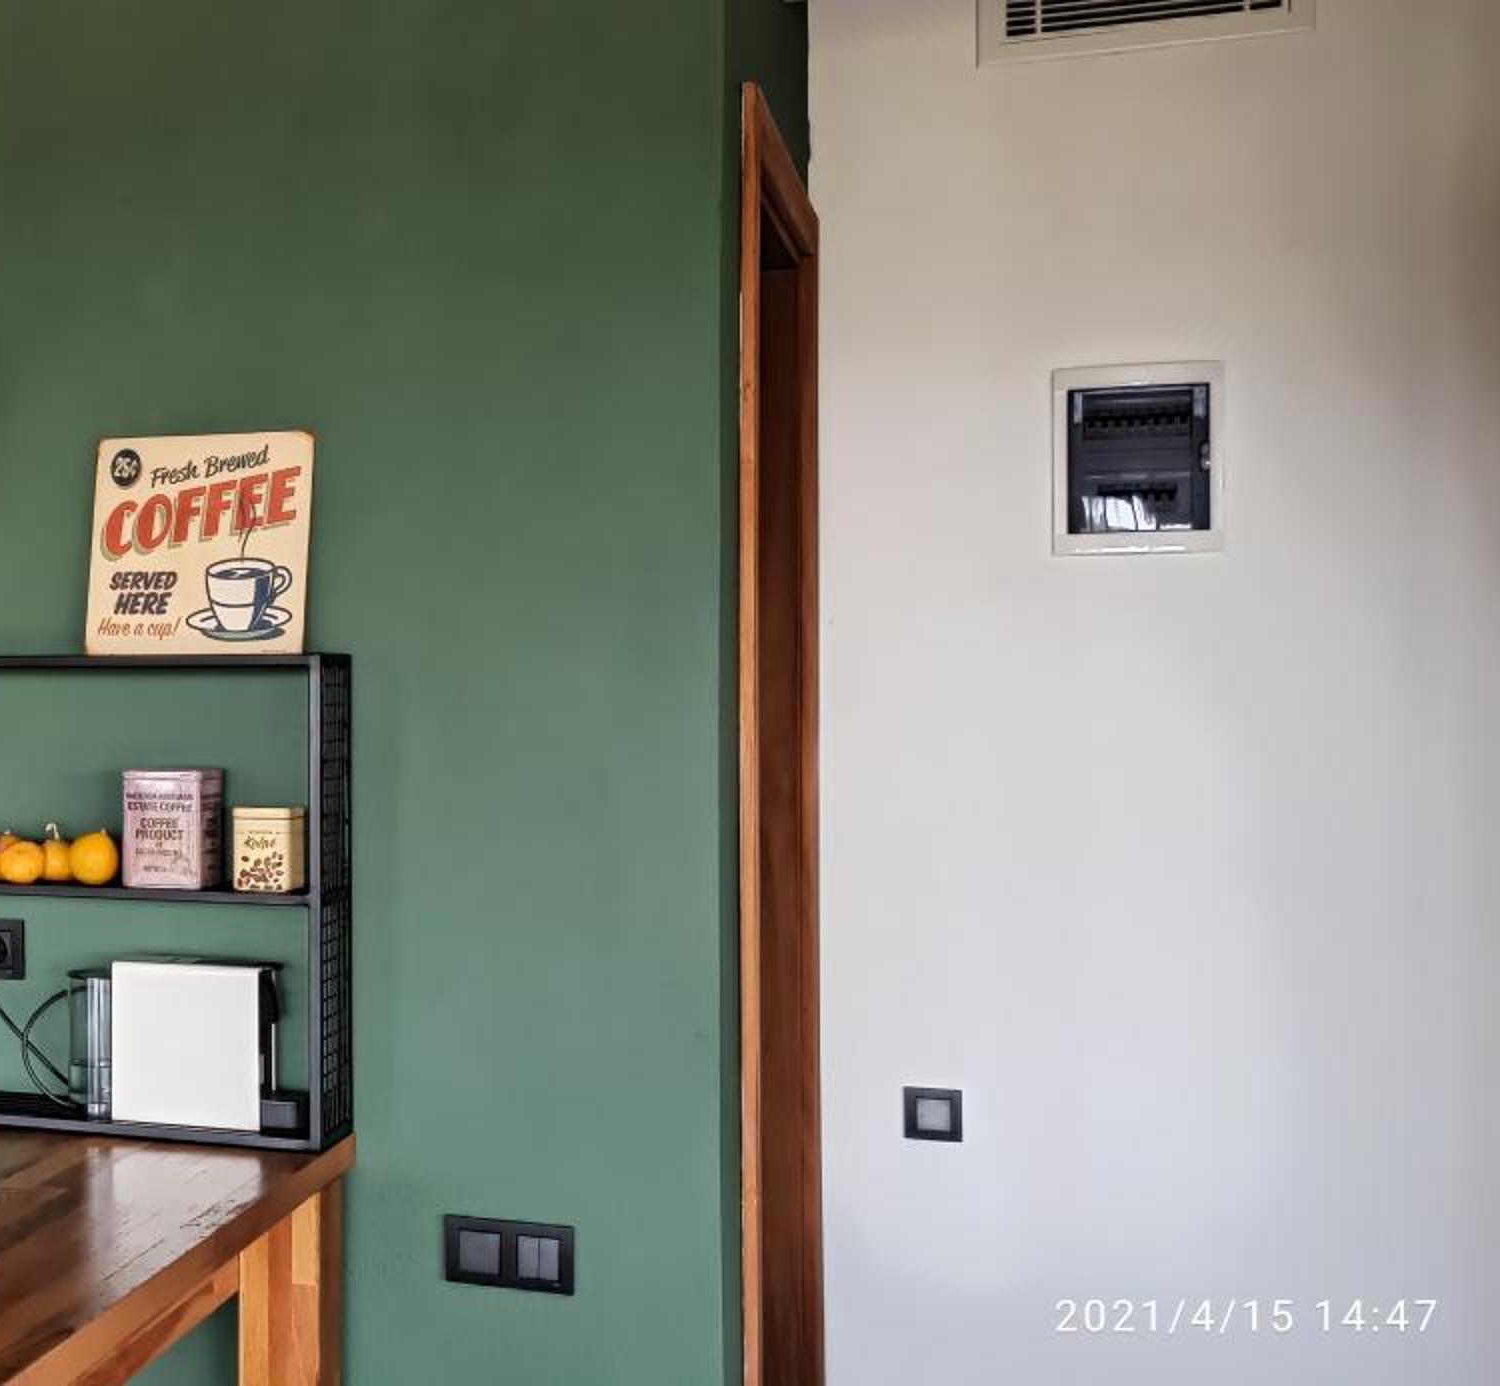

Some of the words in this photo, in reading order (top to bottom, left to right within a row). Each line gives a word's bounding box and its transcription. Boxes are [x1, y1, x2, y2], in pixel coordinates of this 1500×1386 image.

[150, 460, 200, 488] Fresh
[204, 445, 270, 478] Brewed
[103, 466, 301, 560] COFFEE
[109, 571, 178, 591] SERVED
[113, 592, 171, 615] HERE
[97, 618, 132, 637] Have
[133, 621, 146, 636] a
[147, 617, 180, 640] cup!
